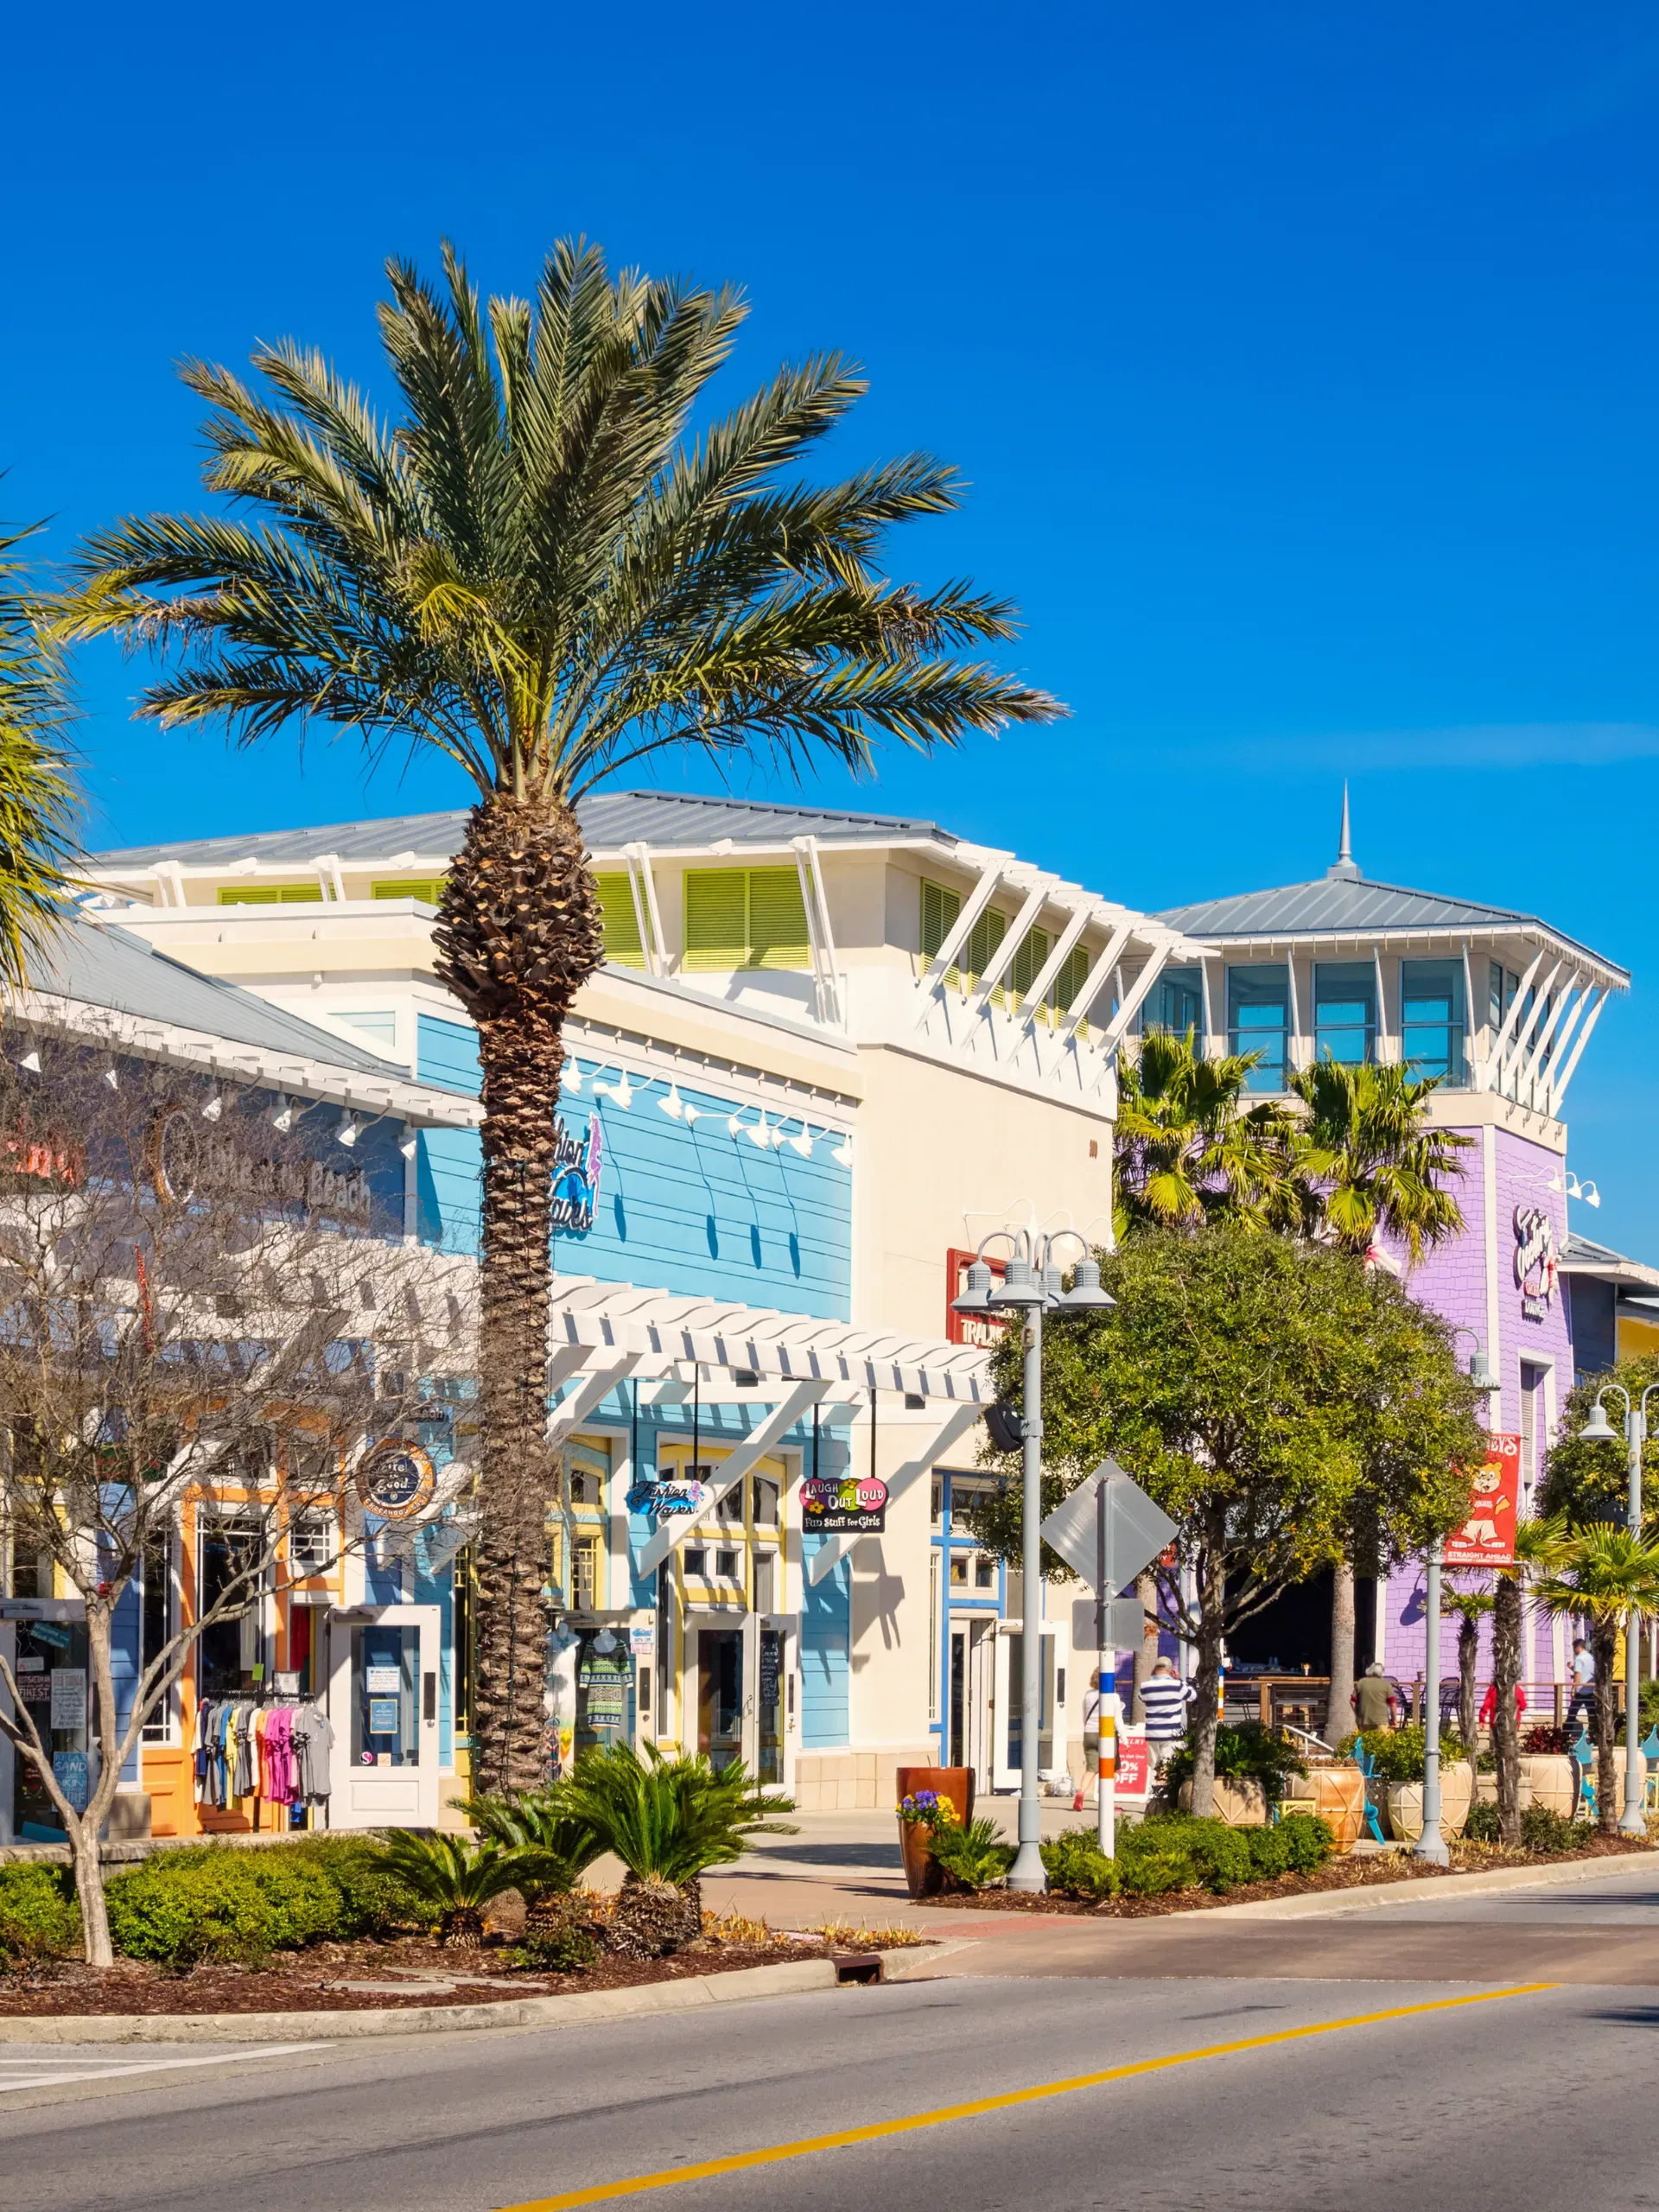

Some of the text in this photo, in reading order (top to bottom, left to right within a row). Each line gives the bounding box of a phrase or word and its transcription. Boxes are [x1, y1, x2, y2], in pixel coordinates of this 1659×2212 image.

[308, 1160, 371, 1214] Beach
[550, 1196, 594, 1232] aves
[632, 1481, 689, 1505] Fashion
[804, 1483, 884, 1510] LAUGH OUT LOUD
[648, 1497, 696, 1515] Waves
[804, 1515, 880, 1529] Fun Stuff for Girls
[19, 1687, 49, 1697] FINEST
[54, 1761, 86, 1773] SAND
